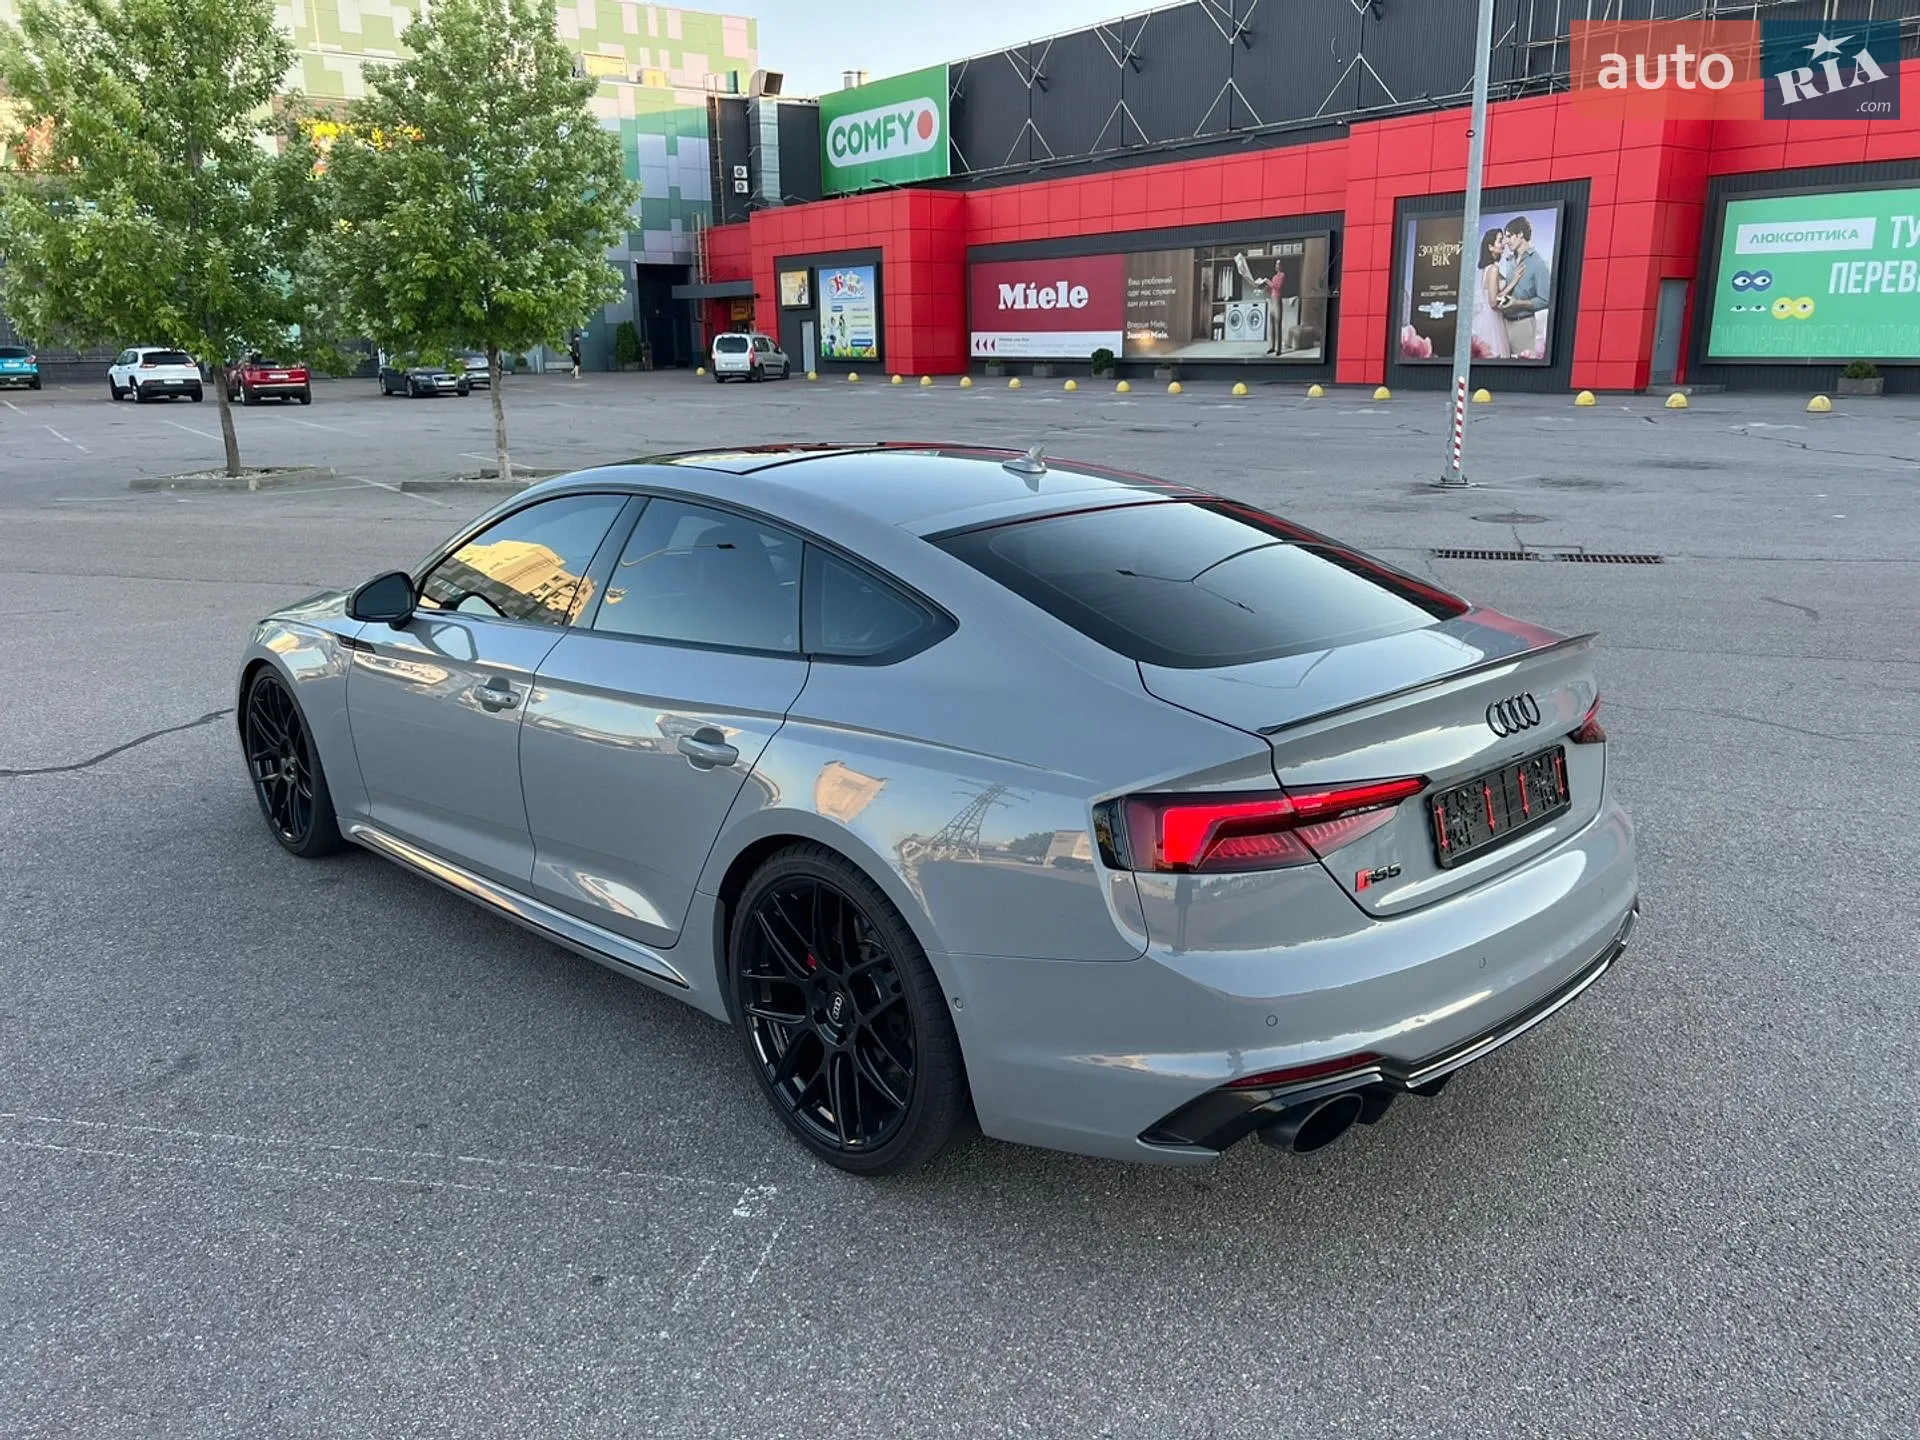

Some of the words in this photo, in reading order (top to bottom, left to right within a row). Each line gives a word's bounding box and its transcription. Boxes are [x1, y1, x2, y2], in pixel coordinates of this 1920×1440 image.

[832, 110, 914, 158] COMFY
[1750, 229, 1859, 244] ЛЮКСОПТИКА
[1828, 260, 1920, 294] ПЕРЕВ
[998, 281, 1088, 310] Miele
